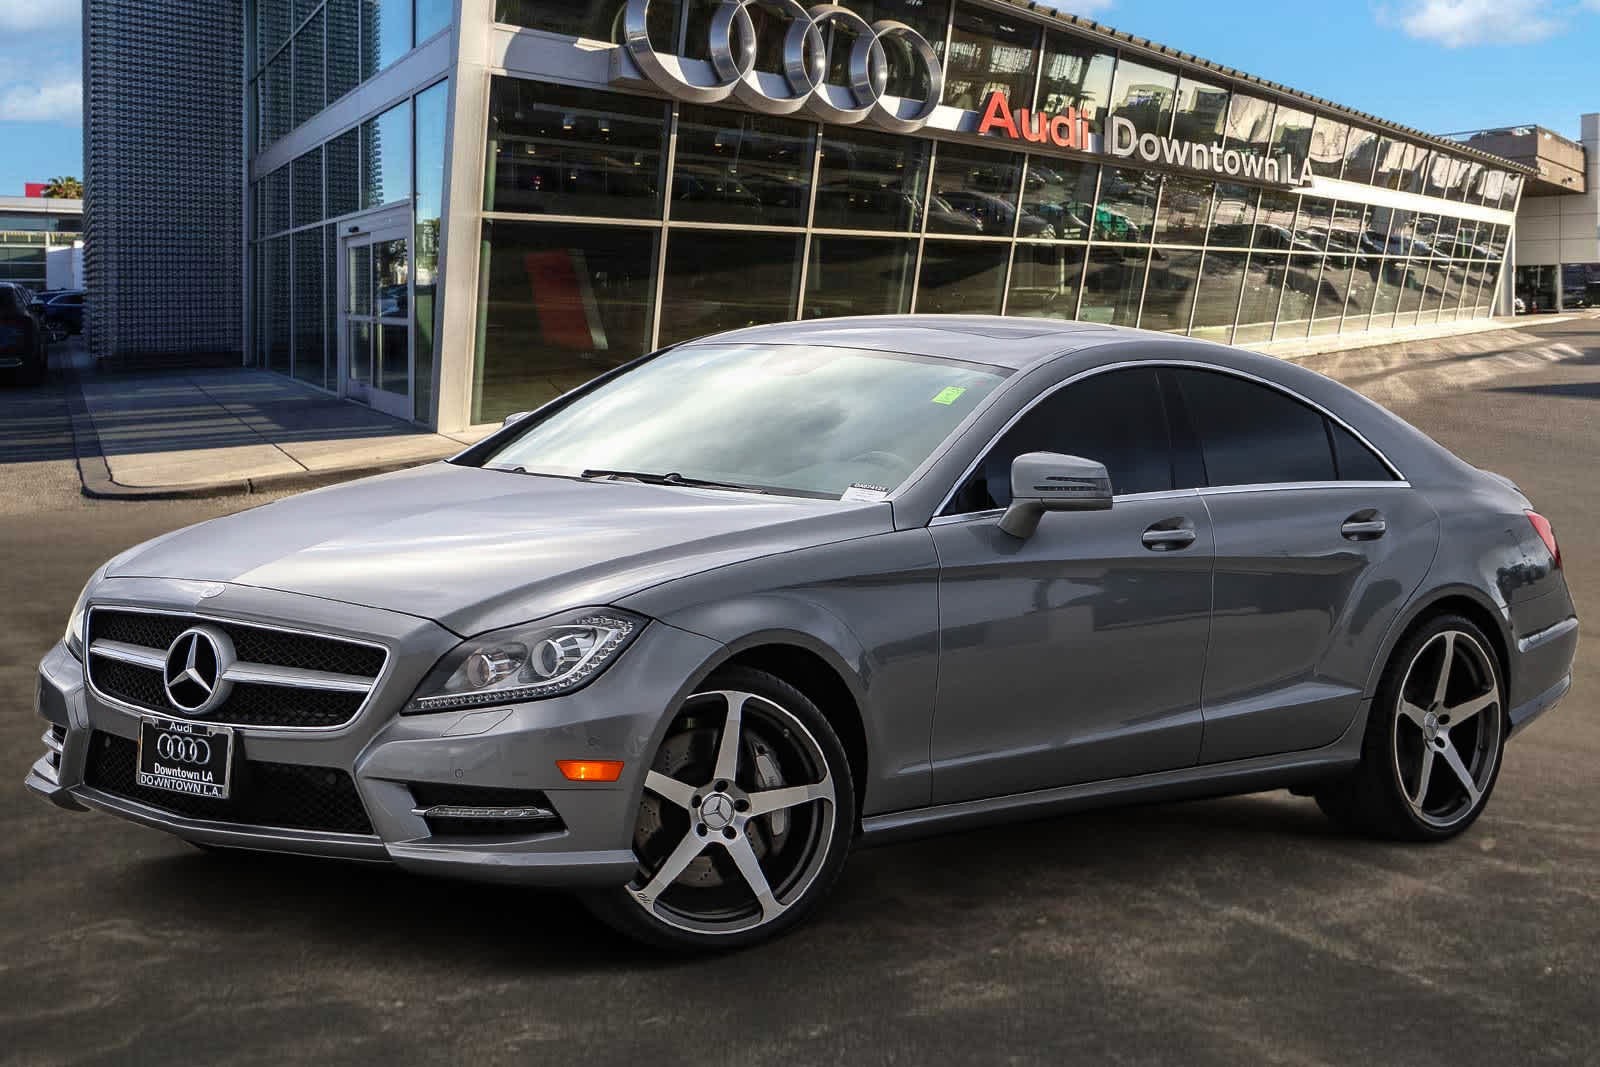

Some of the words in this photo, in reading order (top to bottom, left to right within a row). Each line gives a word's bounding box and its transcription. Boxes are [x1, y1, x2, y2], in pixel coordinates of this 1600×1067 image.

[977, 91, 1089, 150] Audi
[1106, 115, 1280, 183] Downtown
[1285, 152, 1315, 188] LA
[169, 722, 193, 733] Audi
[154, 762, 200, 781] Downtown
[202, 770, 214, 783] LA
[140, 774, 201, 793] DOWNTOWN
[203, 785, 222, 797] L.A.
